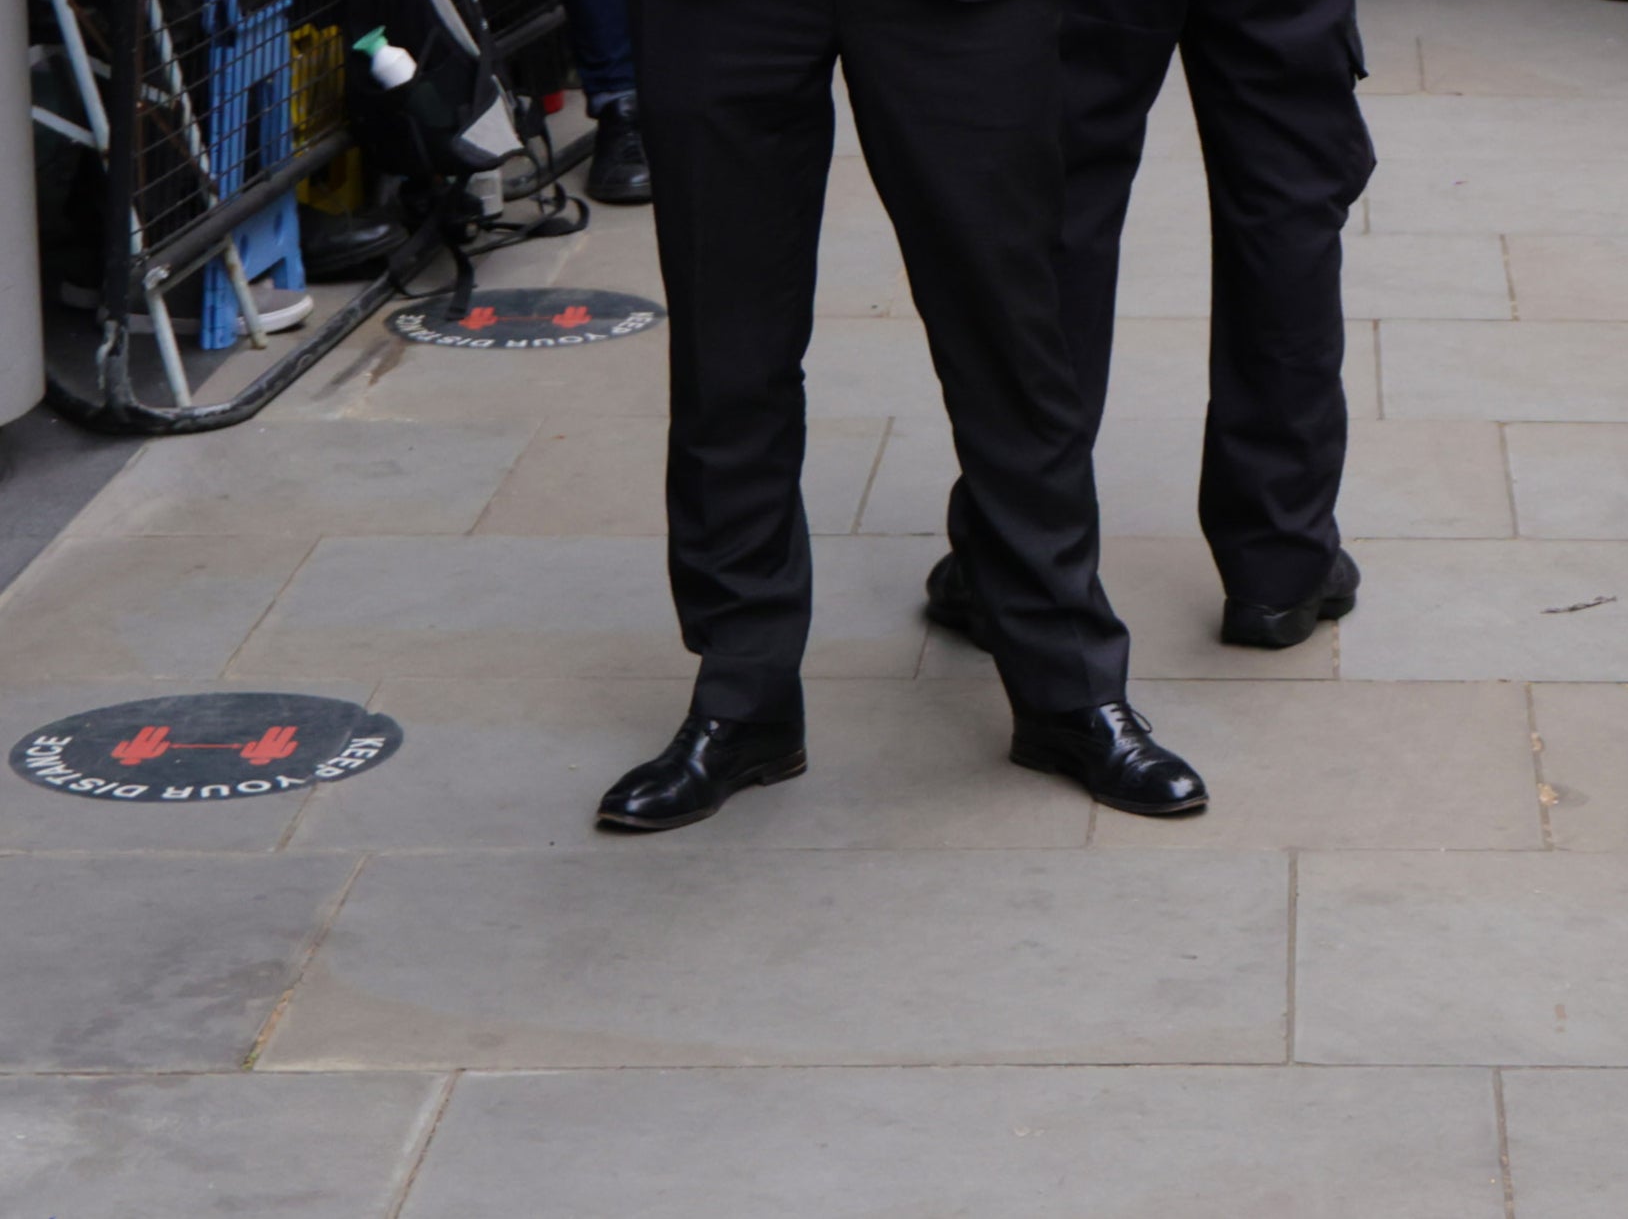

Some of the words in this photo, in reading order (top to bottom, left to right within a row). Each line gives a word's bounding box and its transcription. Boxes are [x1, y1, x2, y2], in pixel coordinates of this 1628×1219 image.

[610, 311, 655, 335] KEEP
[504, 331, 608, 349] YOUR
[25, 734, 150, 799] DISTANCE
[314, 736, 387, 778] KEEP
[161, 774, 307, 800] YOUR
